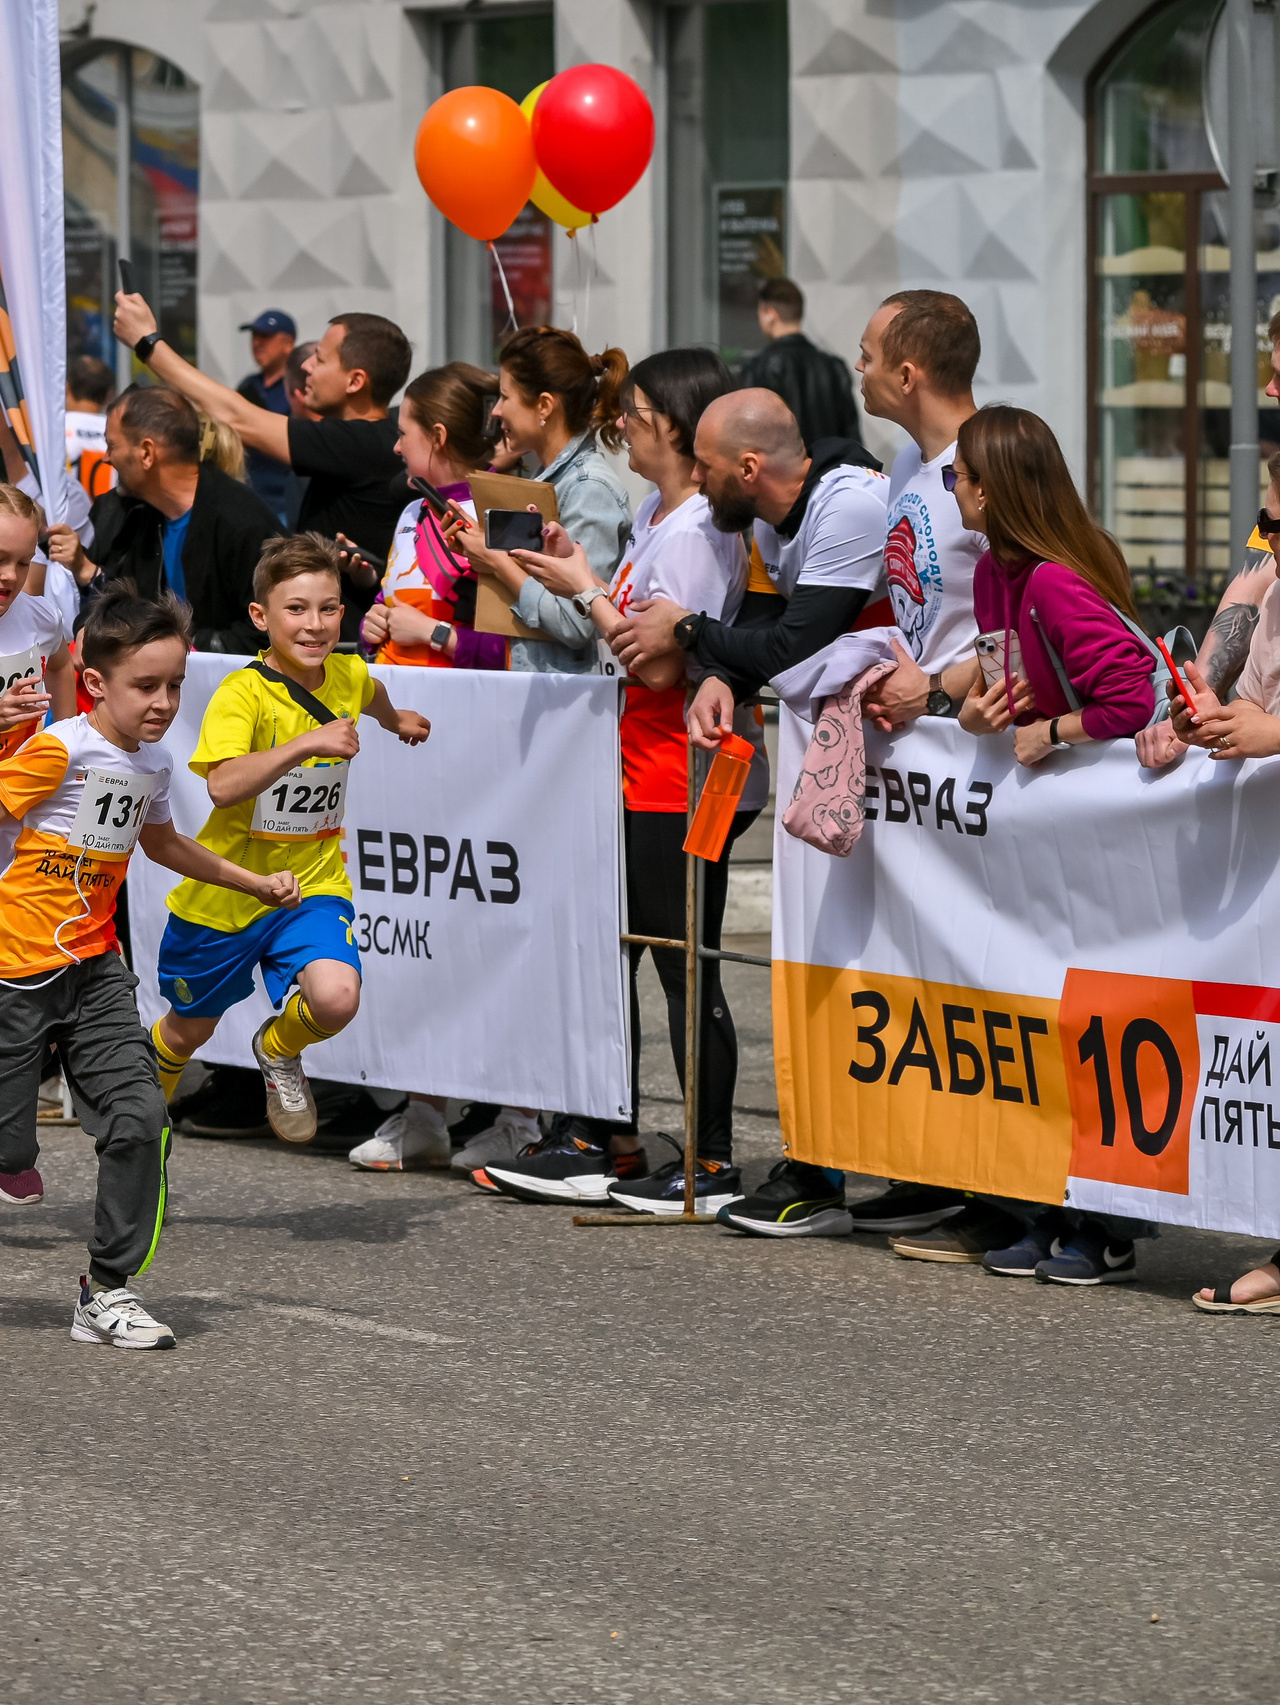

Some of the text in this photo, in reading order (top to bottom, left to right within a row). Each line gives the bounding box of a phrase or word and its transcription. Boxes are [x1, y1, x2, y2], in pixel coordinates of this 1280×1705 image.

[105, 777, 129, 787] ЕВРАЗ
[272, 782, 341, 813] 1226
[95, 792, 148, 828] 131
[865, 765, 993, 837] ЕВРАЗ
[82, 833, 95, 846] 10
[263, 820, 275, 831] 10
[95, 841, 111, 849] ДАЙ
[35, 859, 116, 888] ДАЙ ПЯТЬ!
[357, 829, 521, 905] ЕВРАЗ
[358, 913, 432, 960] ЗСМК
[848, 990, 1183, 1157] ЗАБЕГ 10
[1205, 1031, 1272, 1089] ДАЙ
